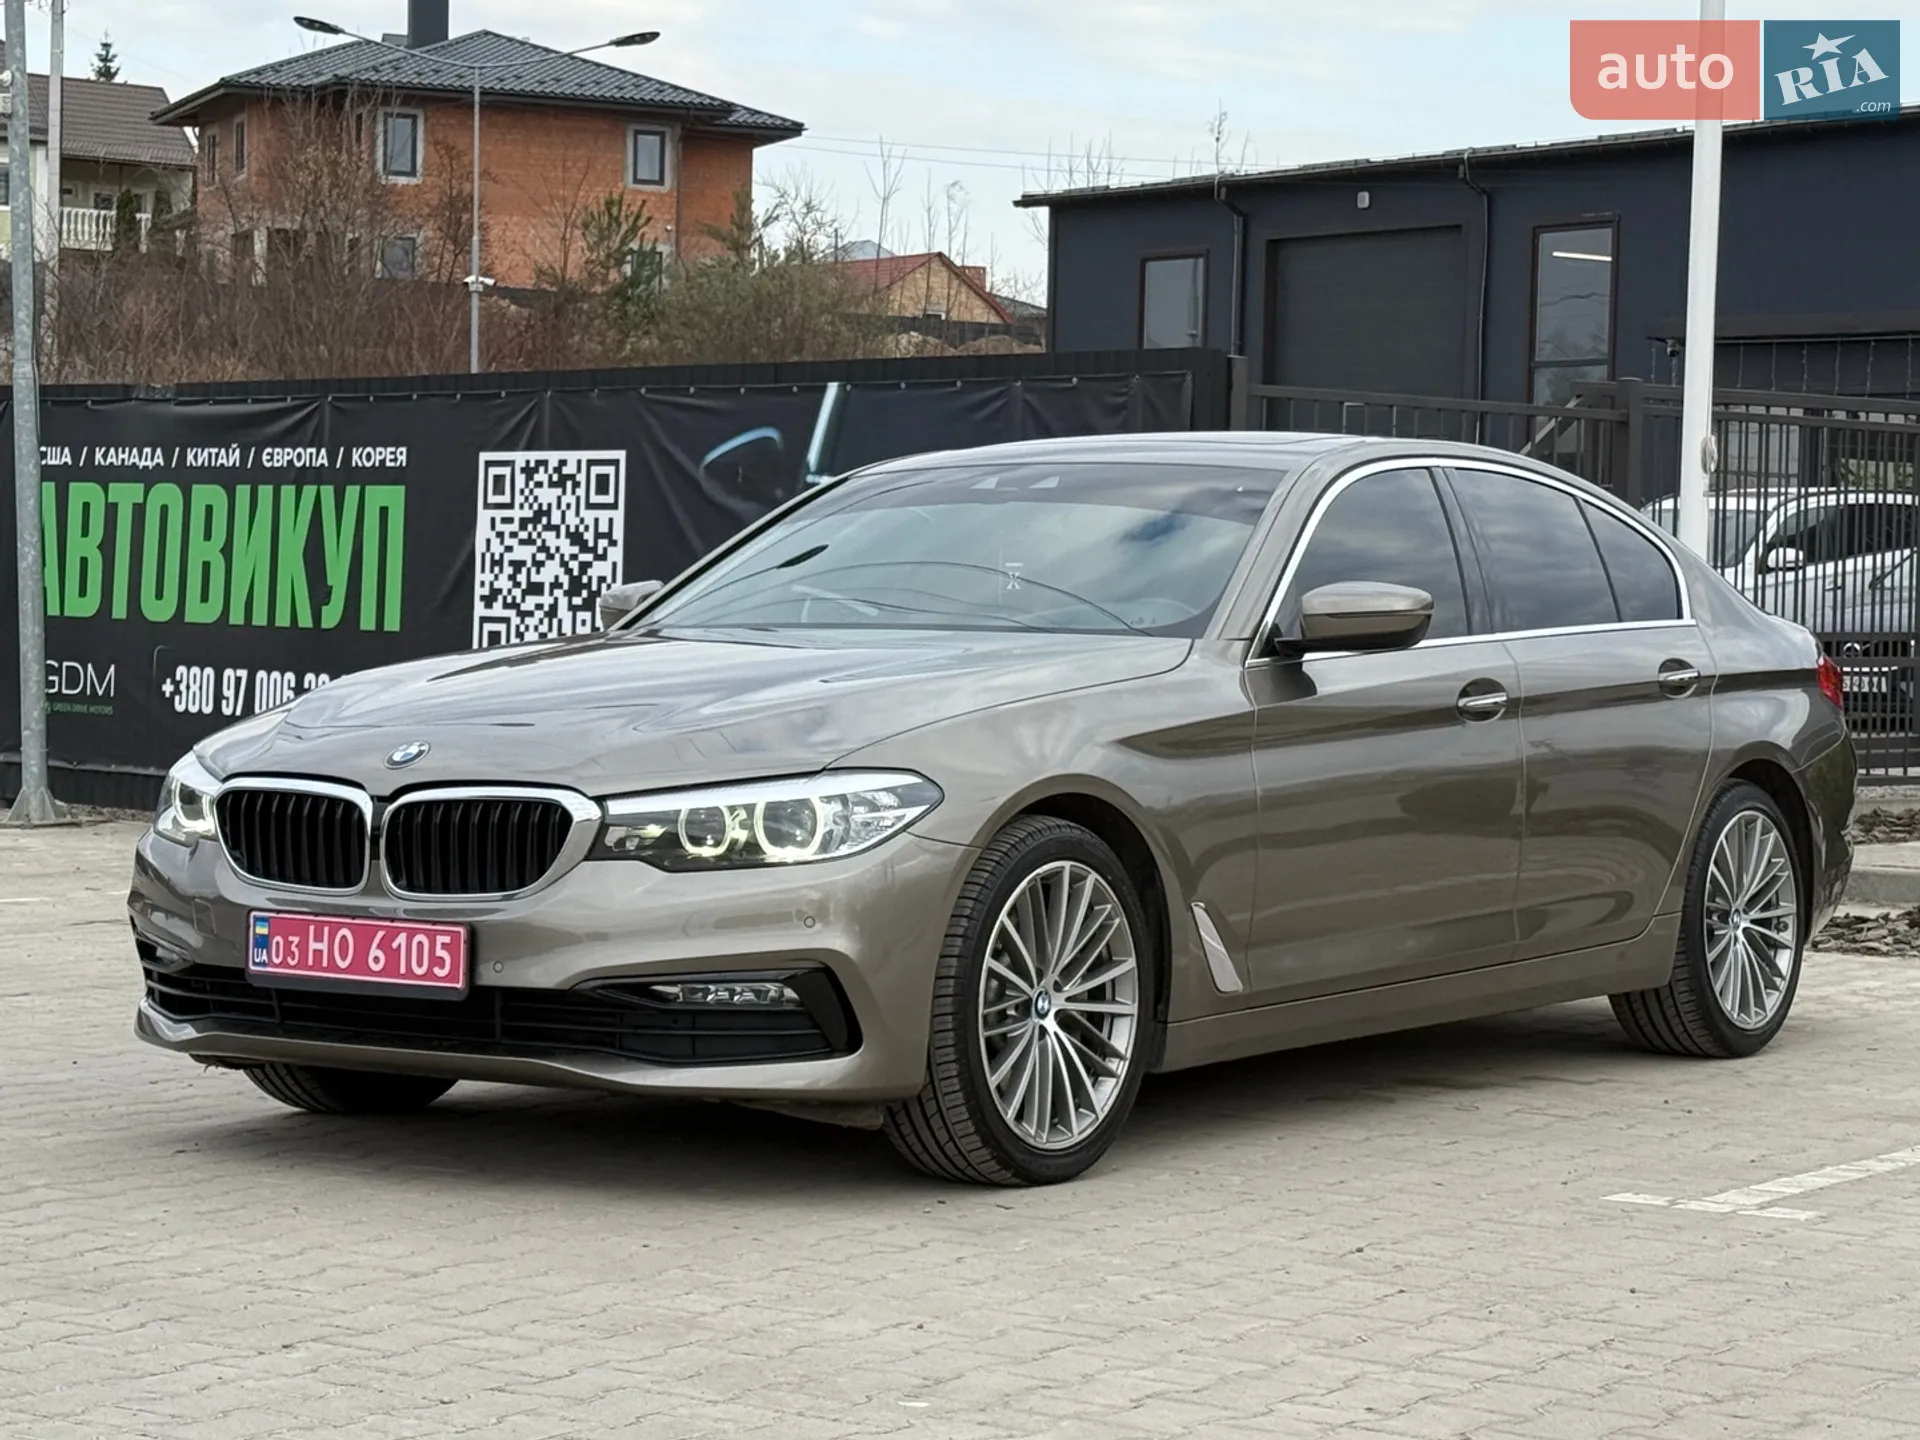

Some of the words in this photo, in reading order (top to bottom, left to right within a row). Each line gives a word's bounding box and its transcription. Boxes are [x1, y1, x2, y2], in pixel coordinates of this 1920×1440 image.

[95, 446, 164, 470] КАНАДА
[186, 443, 240, 467] КИТАЙ
[262, 447, 329, 468] ЄВРОПА
[352, 446, 407, 468] КОРЕЯ
[161, 665, 215, 714] +380
[221, 668, 248, 716] 97
[254, 948, 268, 963] UA
[367, 930, 452, 977] 6105
